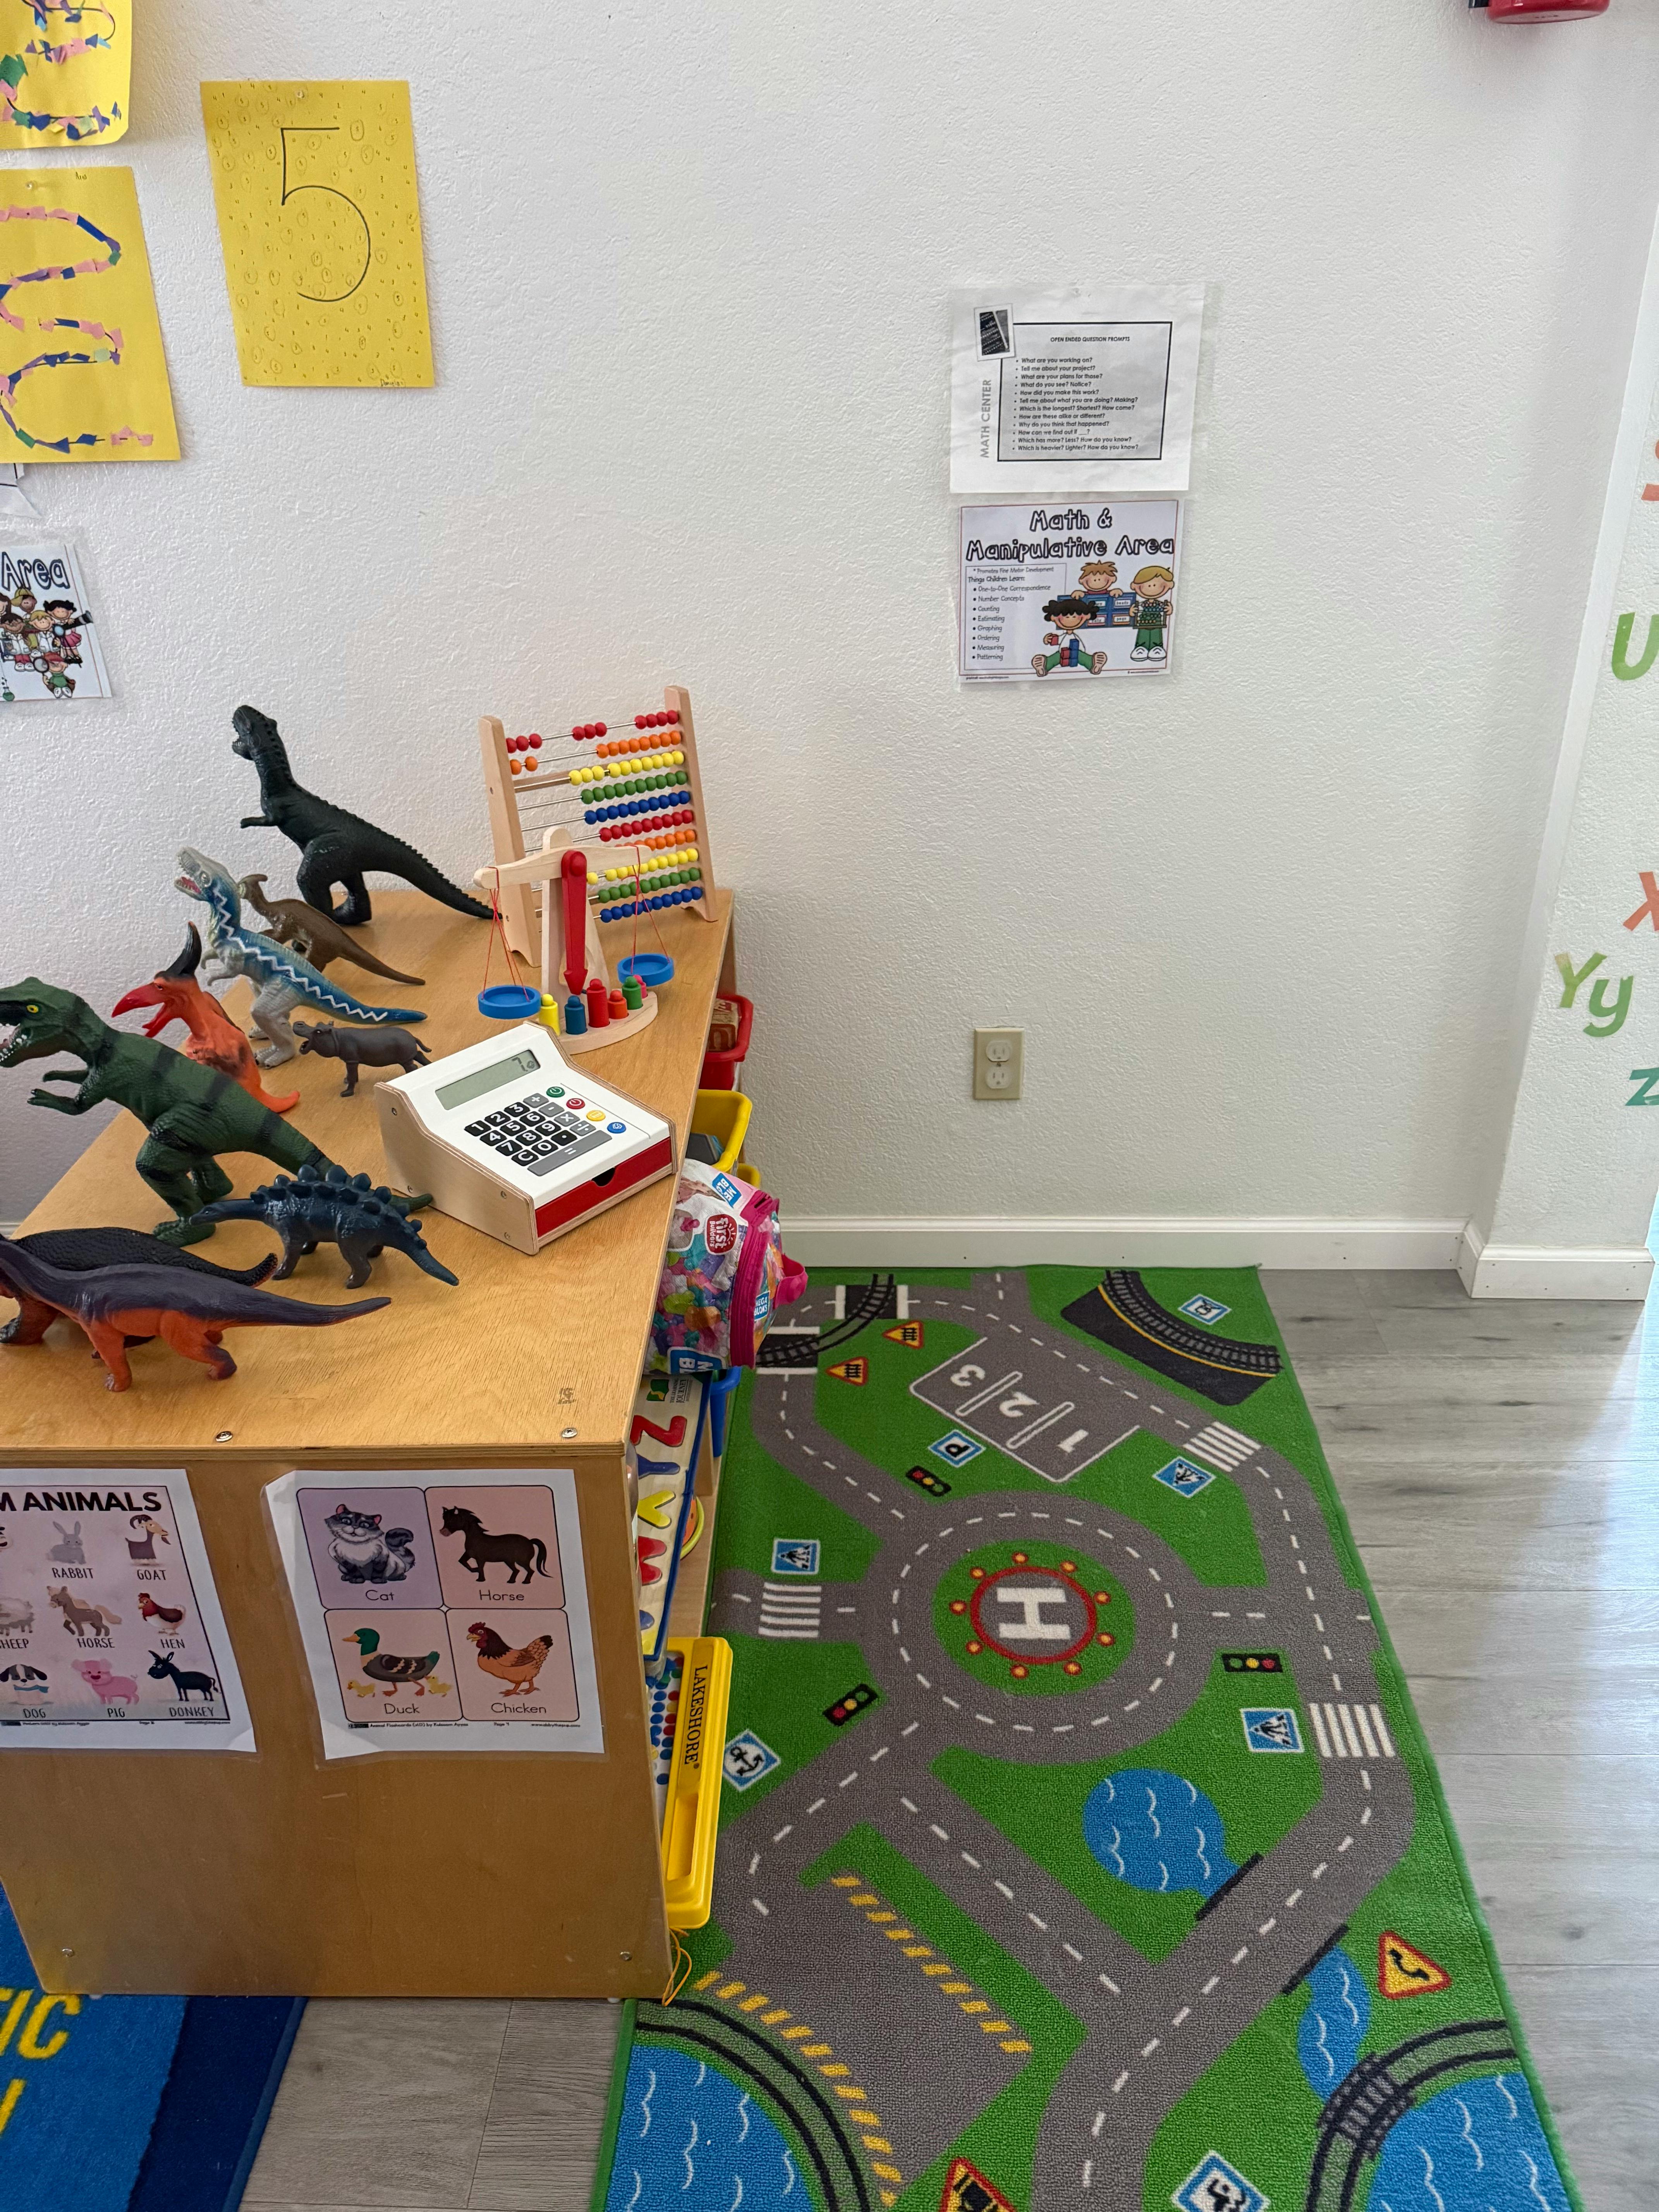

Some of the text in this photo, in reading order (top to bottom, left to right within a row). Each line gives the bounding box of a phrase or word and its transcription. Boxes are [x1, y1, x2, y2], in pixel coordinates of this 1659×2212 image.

[281, 127, 371, 302] 5
[980, 380, 991, 458] MATH CENTER
[1030, 508, 1112, 531] Math &
[966, 535, 1175, 562] Manipulative Area
[2, 551, 70, 590] Area
[1554, 952, 1633, 1037] Yy
[490, 1114, 505, 1122] 2
[509, 1104, 524, 1113] 3
[506, 1122, 520, 1131] 5
[527, 1113, 540, 1121] 6
[542, 1123, 555, 1131] 9
[518, 1142, 552, 1161] C 0
[950, 1365, 985, 1387] 3
[999, 1391, 1038, 1418] 2
[1057, 1429, 1089, 1453] 1
[23, 1492, 162, 1511] ANIMALS
[52, 1568, 93, 1579] RABBIT
[137, 1570, 167, 1581] GOAT
[366, 1590, 394, 1602] Cat
[480, 1590, 524, 1601] Horse
[996, 1587, 1071, 1640] H
[77, 1637, 115, 1648] HORSE
[161, 1639, 185, 1649] HEN
[23, 1708, 46, 1718] DOG
[108, 1708, 125, 1717] PIG
[169, 1707, 215, 1717] DONKEY
[385, 1703, 419, 1714] Duck
[491, 1702, 547, 1714] Chicken
[684, 1665, 708, 1765] LAKESHORE
